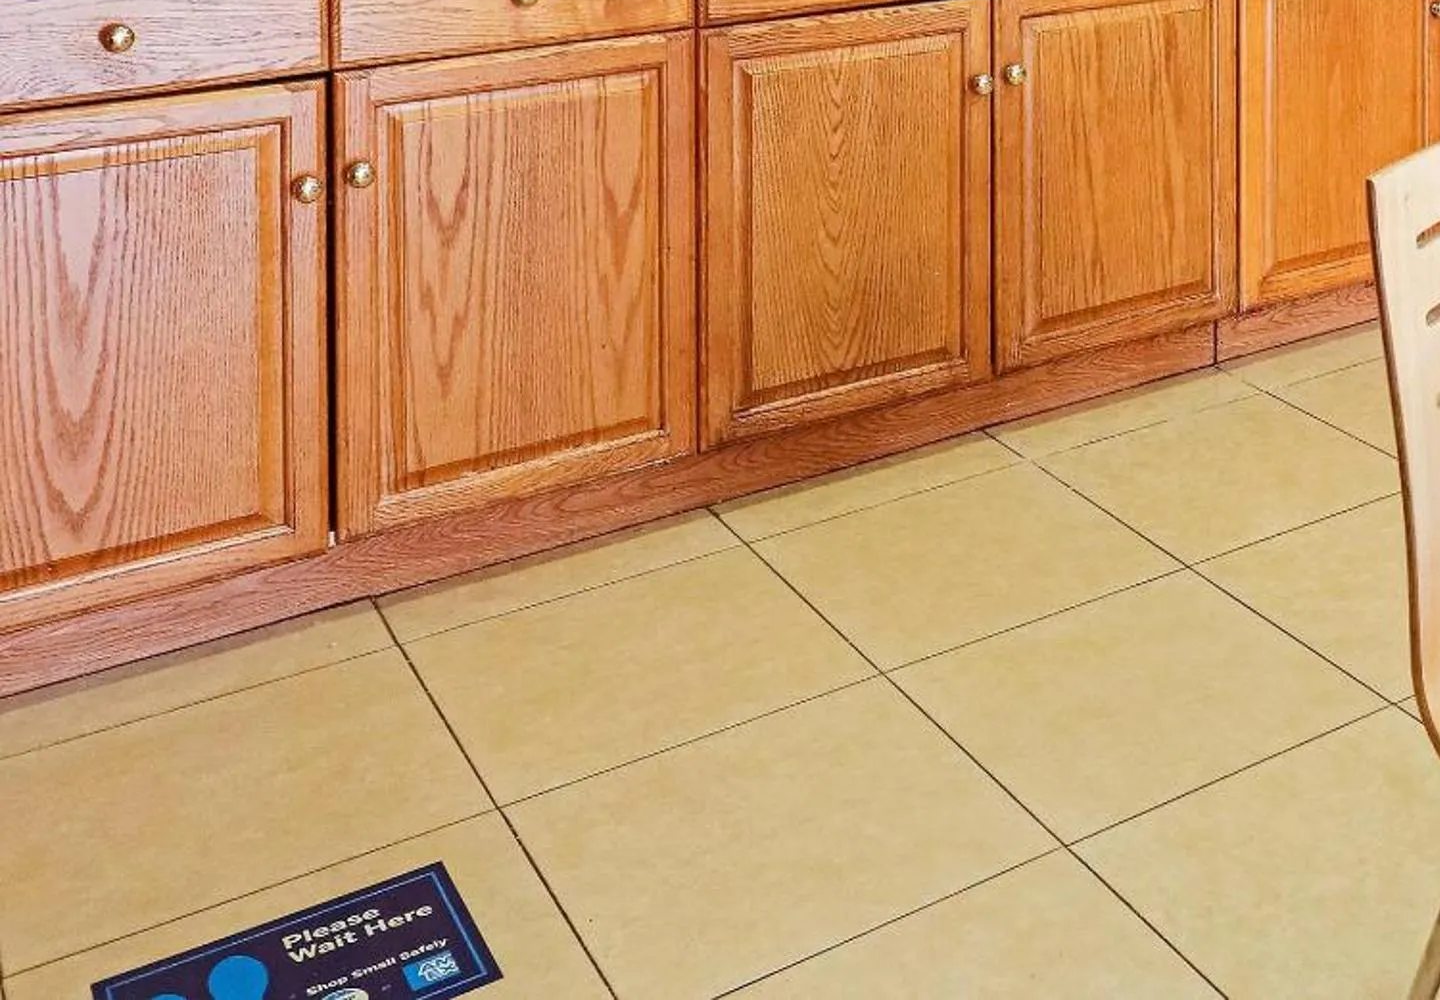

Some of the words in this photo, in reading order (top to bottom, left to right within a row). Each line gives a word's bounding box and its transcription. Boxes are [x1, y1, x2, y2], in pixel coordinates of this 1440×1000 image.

[281, 908, 380, 950] Please
[287, 930, 358, 963] Wait
[364, 904, 433, 937] Here
[306, 976, 349, 997] Shop
[351, 956, 397, 979] Small
[400, 936, 449, 961] Safely
